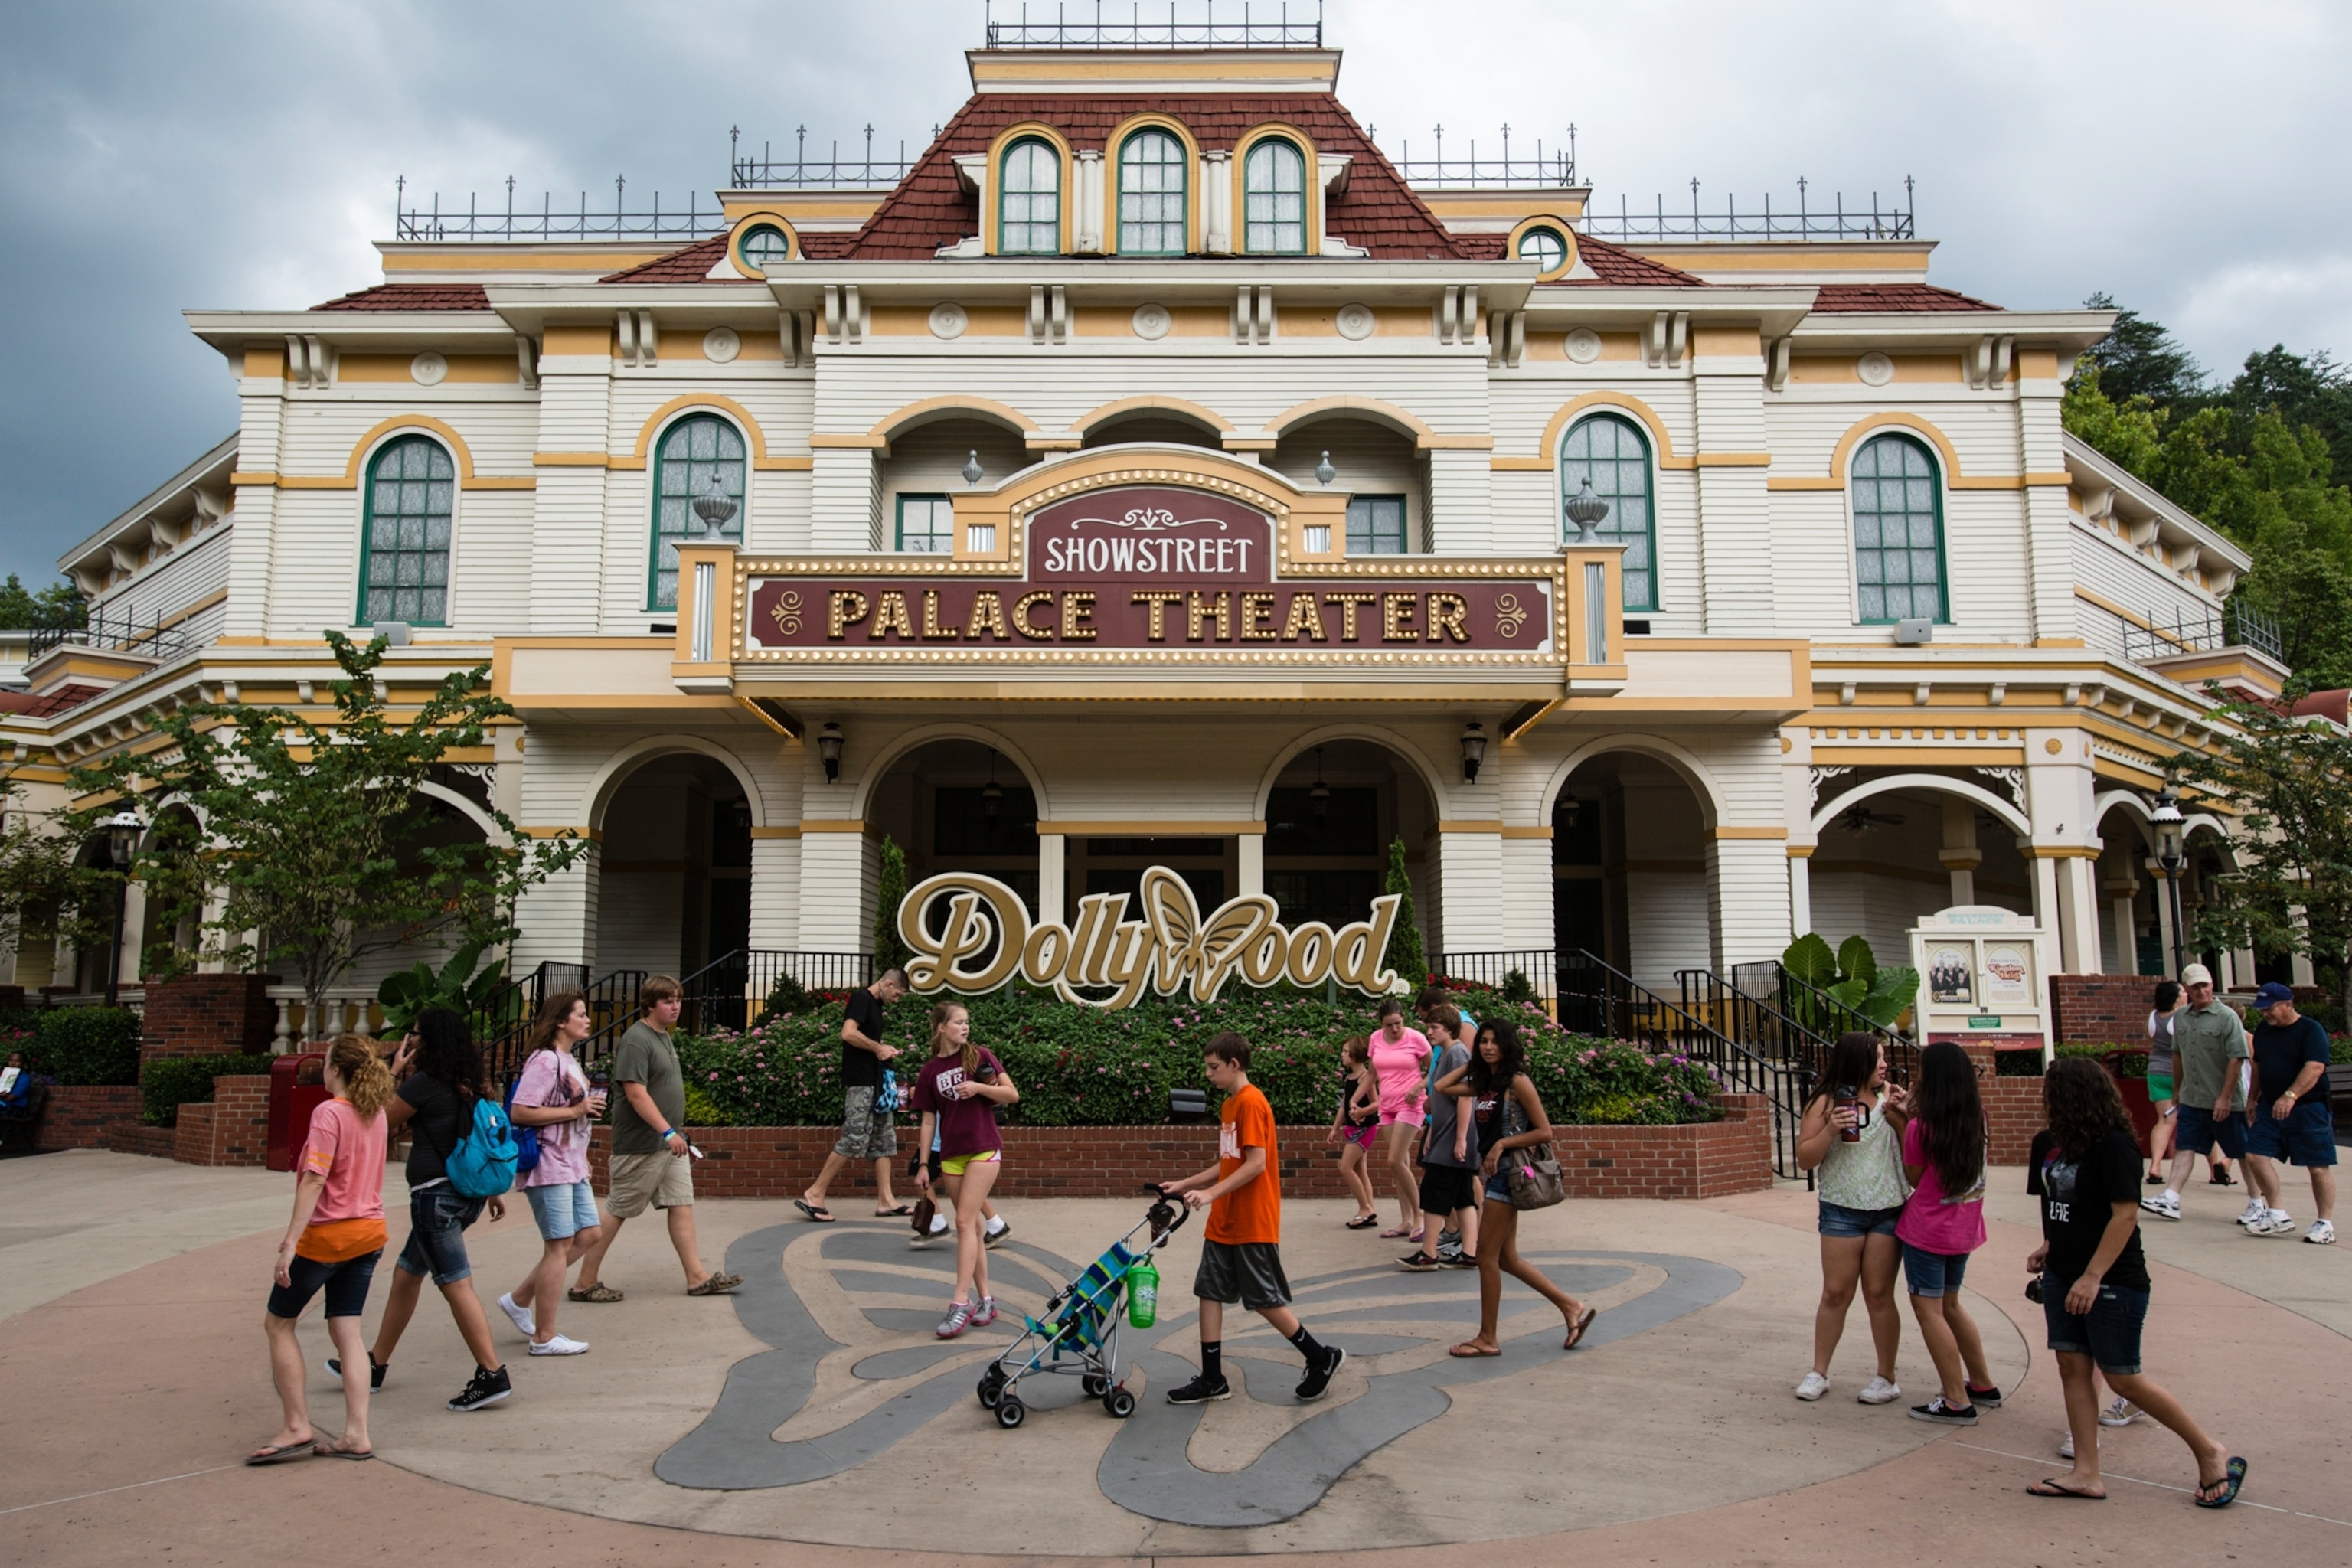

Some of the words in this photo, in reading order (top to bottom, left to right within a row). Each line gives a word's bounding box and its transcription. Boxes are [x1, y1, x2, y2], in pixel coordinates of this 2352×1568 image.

[1044, 537, 1254, 573] SHOWSTREET
[827, 589, 1098, 640] PALACE
[1131, 590, 1472, 642] THEATER
